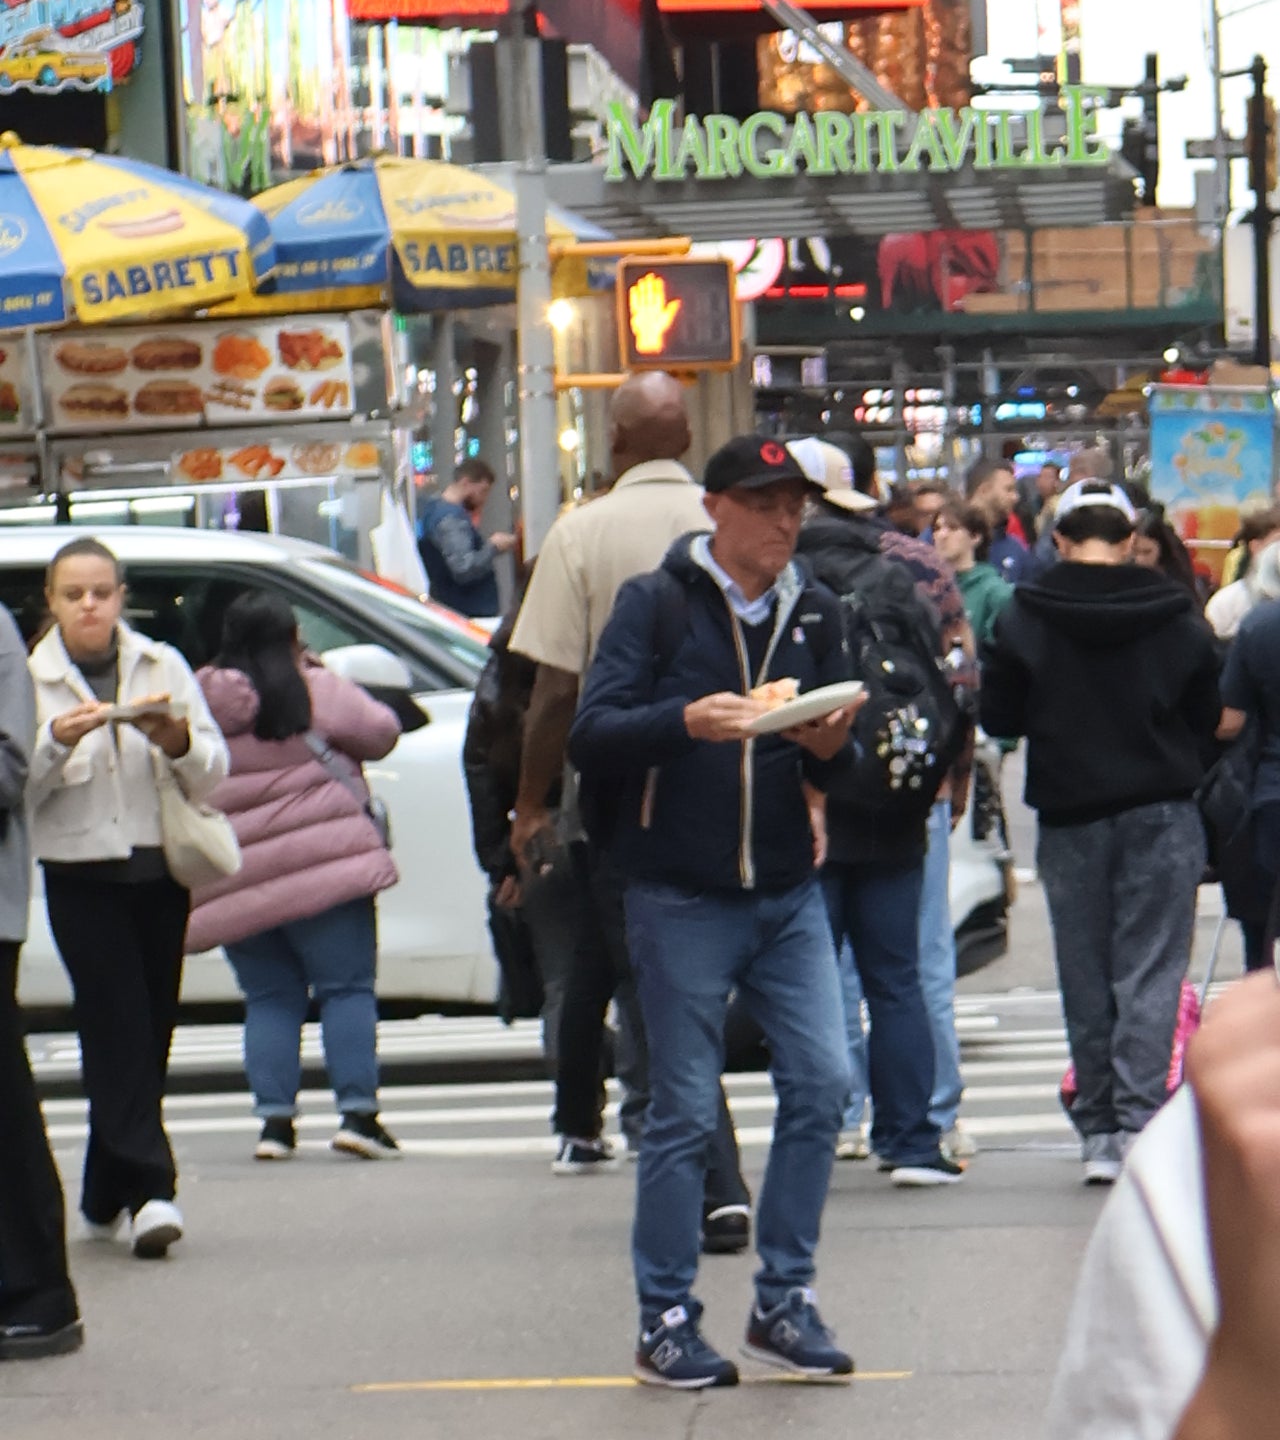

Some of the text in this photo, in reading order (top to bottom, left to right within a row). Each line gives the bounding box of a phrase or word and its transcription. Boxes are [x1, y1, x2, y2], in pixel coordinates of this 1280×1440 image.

[603, 85, 1108, 182] MARGARITAVILLE
[82, 249, 240, 305] SABRETT
[404, 242, 515, 273] SABRE
